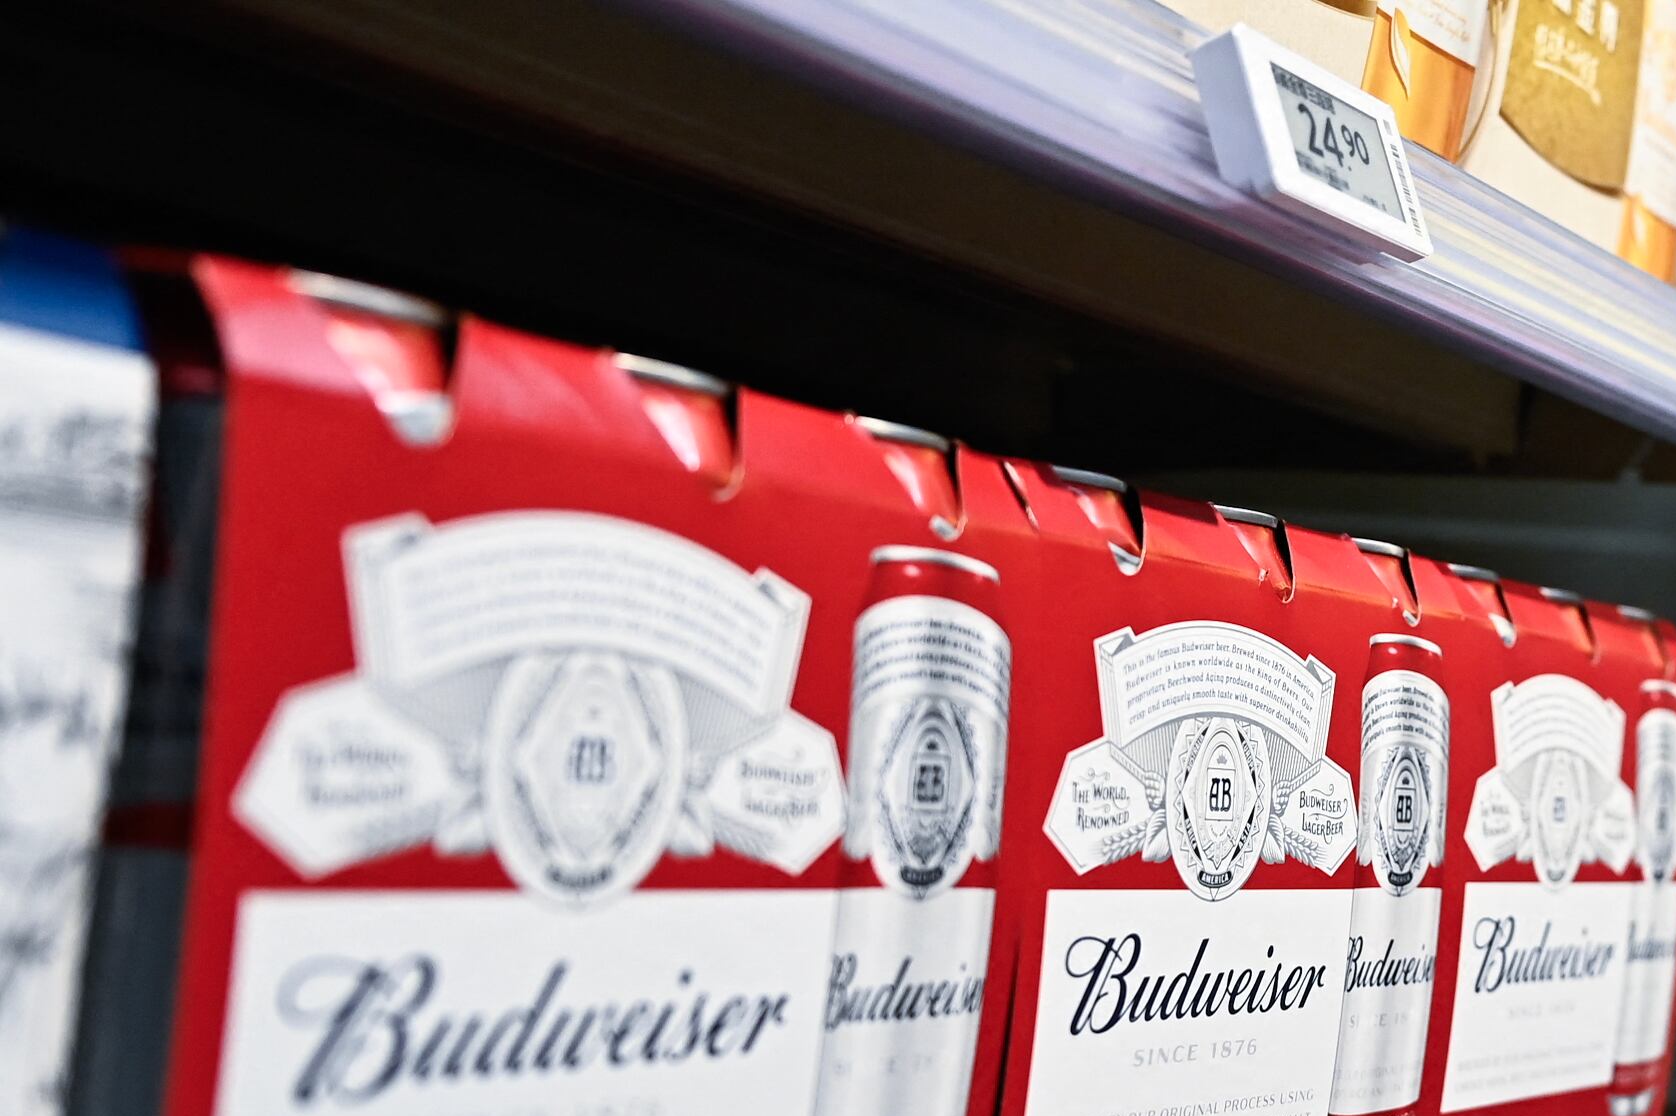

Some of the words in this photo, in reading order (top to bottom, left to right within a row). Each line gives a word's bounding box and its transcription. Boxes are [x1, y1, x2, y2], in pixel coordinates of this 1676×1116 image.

[1182, 641, 1215, 653] Budweiser
[1231, 643, 1255, 659] Brewed
[1256, 652, 1271, 667] since
[1162, 690, 1191, 708] uniquely
[1192, 687, 1216, 700] smooth
[1234, 691, 1248, 704] with
[1249, 698, 1276, 716] superior
[1167, 672, 1204, 689] Beechwood
[1205, 671, 1225, 684] Aging
[1225, 673, 1254, 691] produces
[1260, 685, 1296, 715] distinctively
[1198, 655, 1234, 668] worldwide
[1245, 661, 1255, 675] the
[1257, 667, 1272, 684] King
[1273, 677, 1281, 688] of
[1301, 697, 1313, 713] Our
[1299, 790, 1342, 813] BUDWEISER
[1345, 935, 1437, 992] Budweise
[1473, 915, 1616, 994] Budweiser
[825, 953, 986, 1032] Budweise
[1065, 933, 1327, 1035] Budweiser
[277, 953, 788, 1108] Budweiser
[1132, 1043, 1199, 1068] SINCE
[1210, 1038, 1259, 1059] 1876
[1223, 1092, 1276, 1113] PROCESS
[1279, 1088, 1315, 1105] USING
